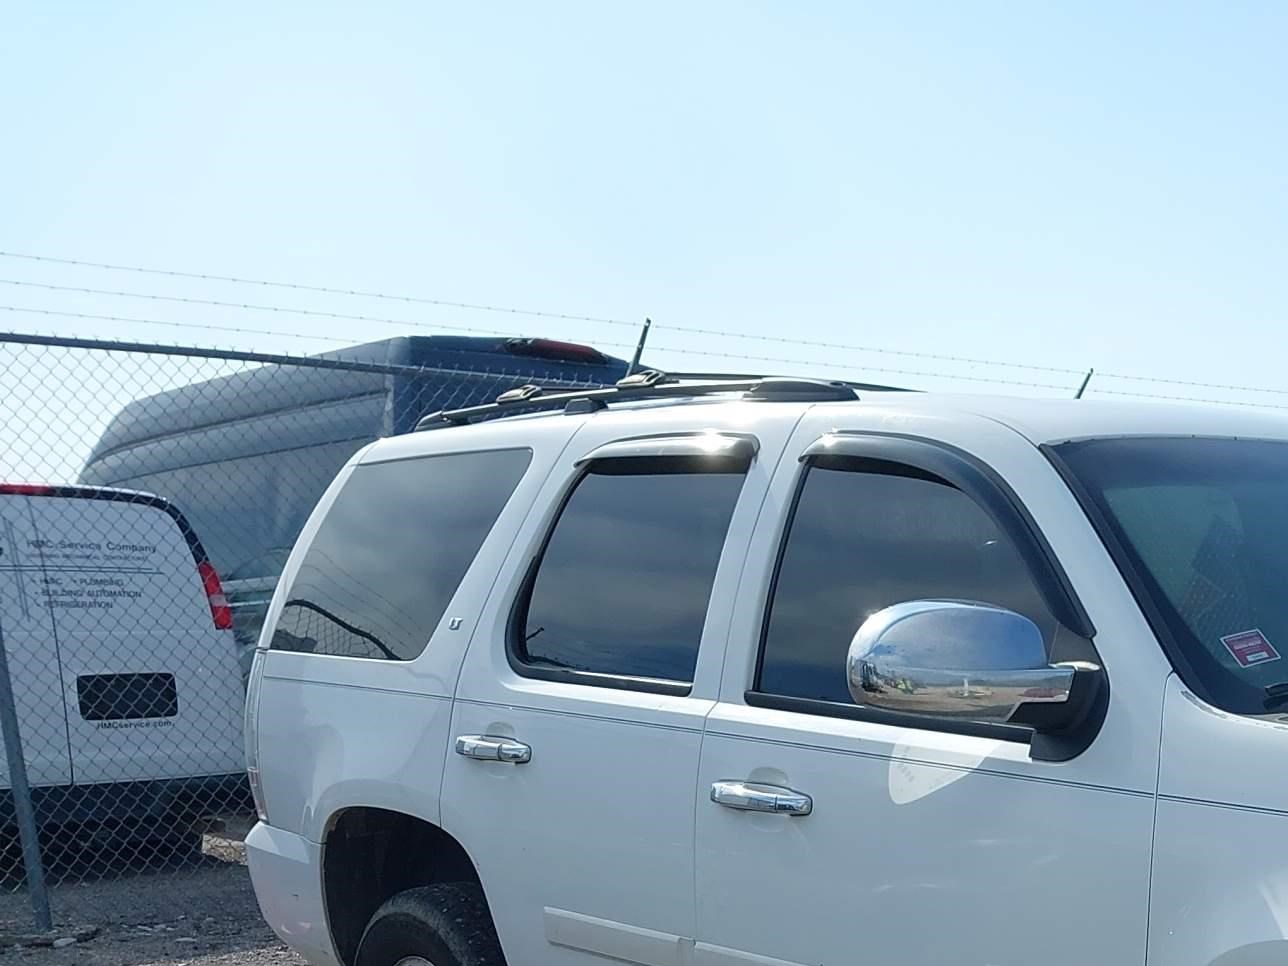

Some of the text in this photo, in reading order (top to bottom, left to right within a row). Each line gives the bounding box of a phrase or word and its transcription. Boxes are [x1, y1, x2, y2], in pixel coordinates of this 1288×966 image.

[60, 540, 102, 550] Service
[105, 541, 157, 553] Company
[87, 589, 142, 598] AUTOMATION
